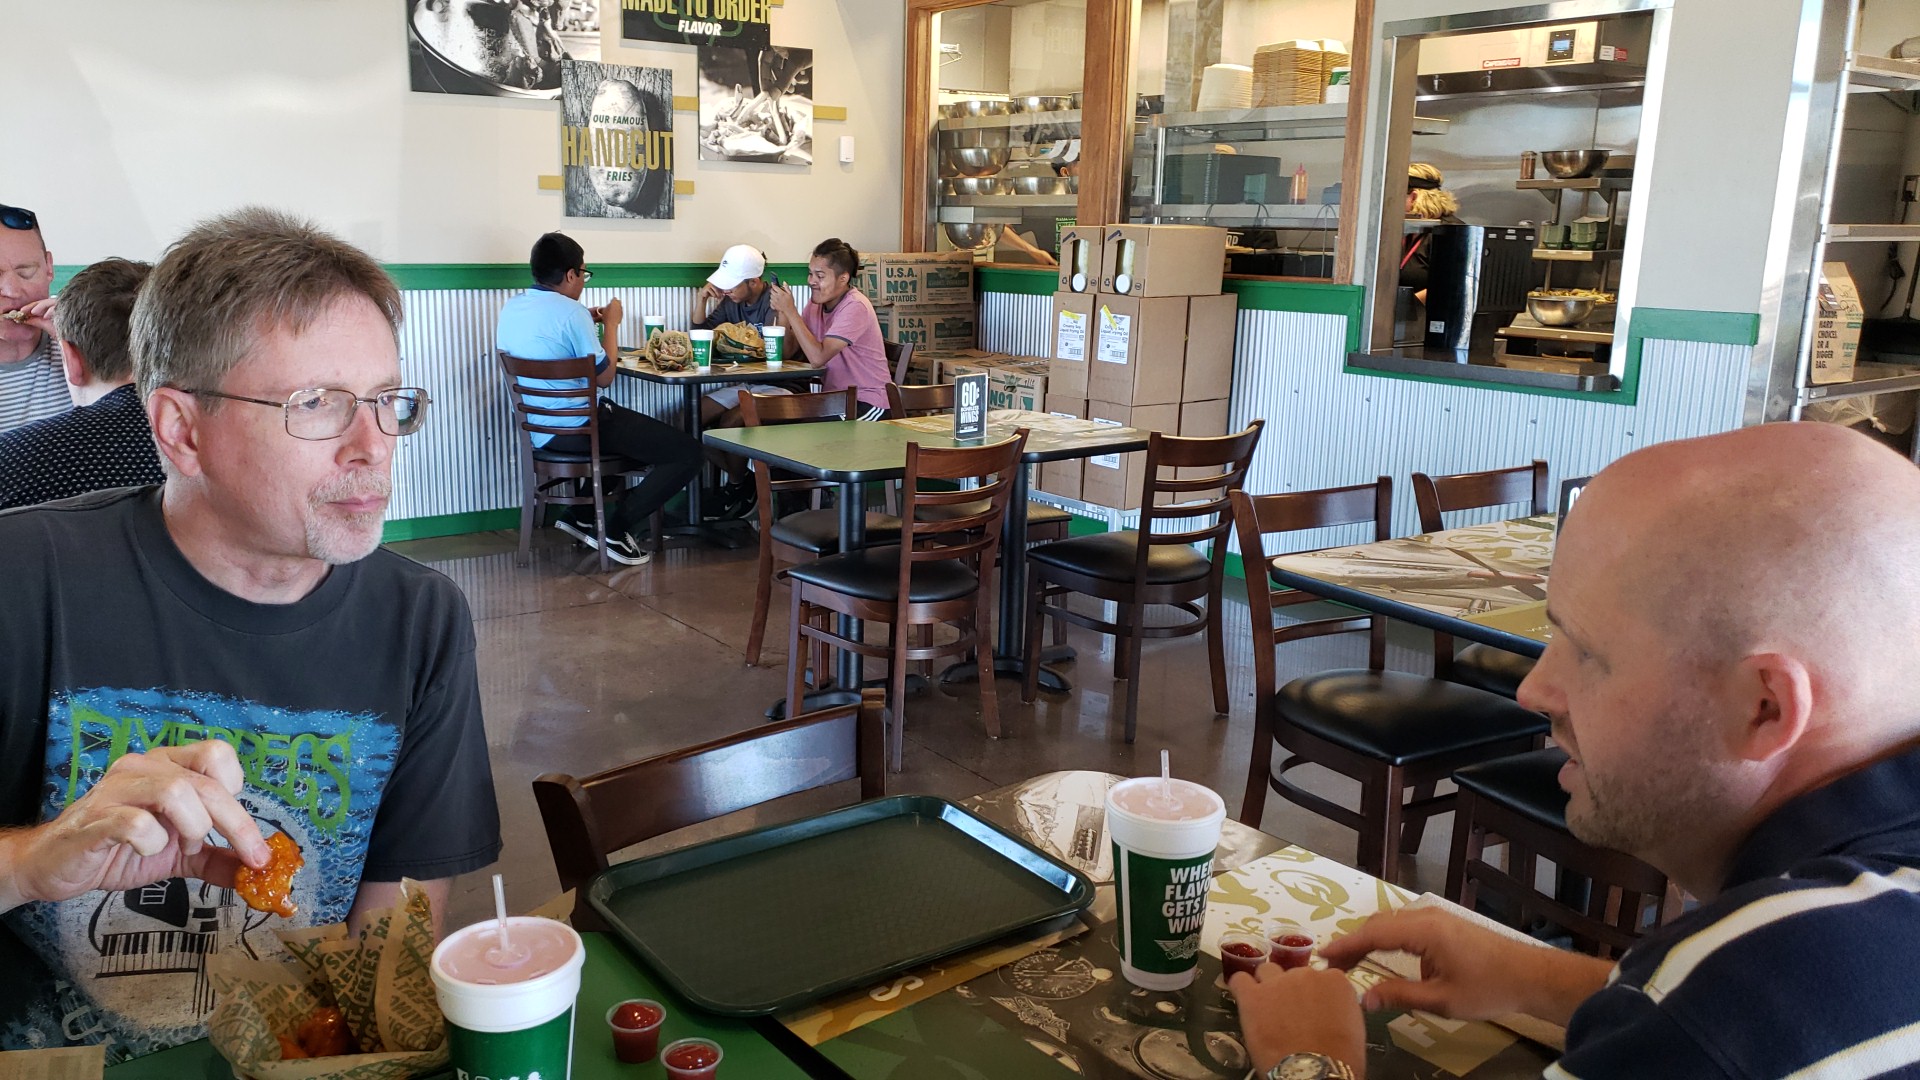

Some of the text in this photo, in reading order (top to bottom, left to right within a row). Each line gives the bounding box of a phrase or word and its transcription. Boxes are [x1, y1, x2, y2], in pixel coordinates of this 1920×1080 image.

[677, 19, 722, 36] FLAVOR
[592, 114, 645, 126] OUR FAMOUS
[561, 124, 674, 171] HANDCUT
[606, 170, 633, 182] FRIES
[885, 267, 918, 278] U.S.A.
[886, 294, 917, 303] POTATOES
[899, 318, 926, 329] U.S.A.
[1170, 858, 1214, 884] WHER
[1165, 875, 1212, 901] FLAVO
[1161, 898, 1200, 918] GETS
